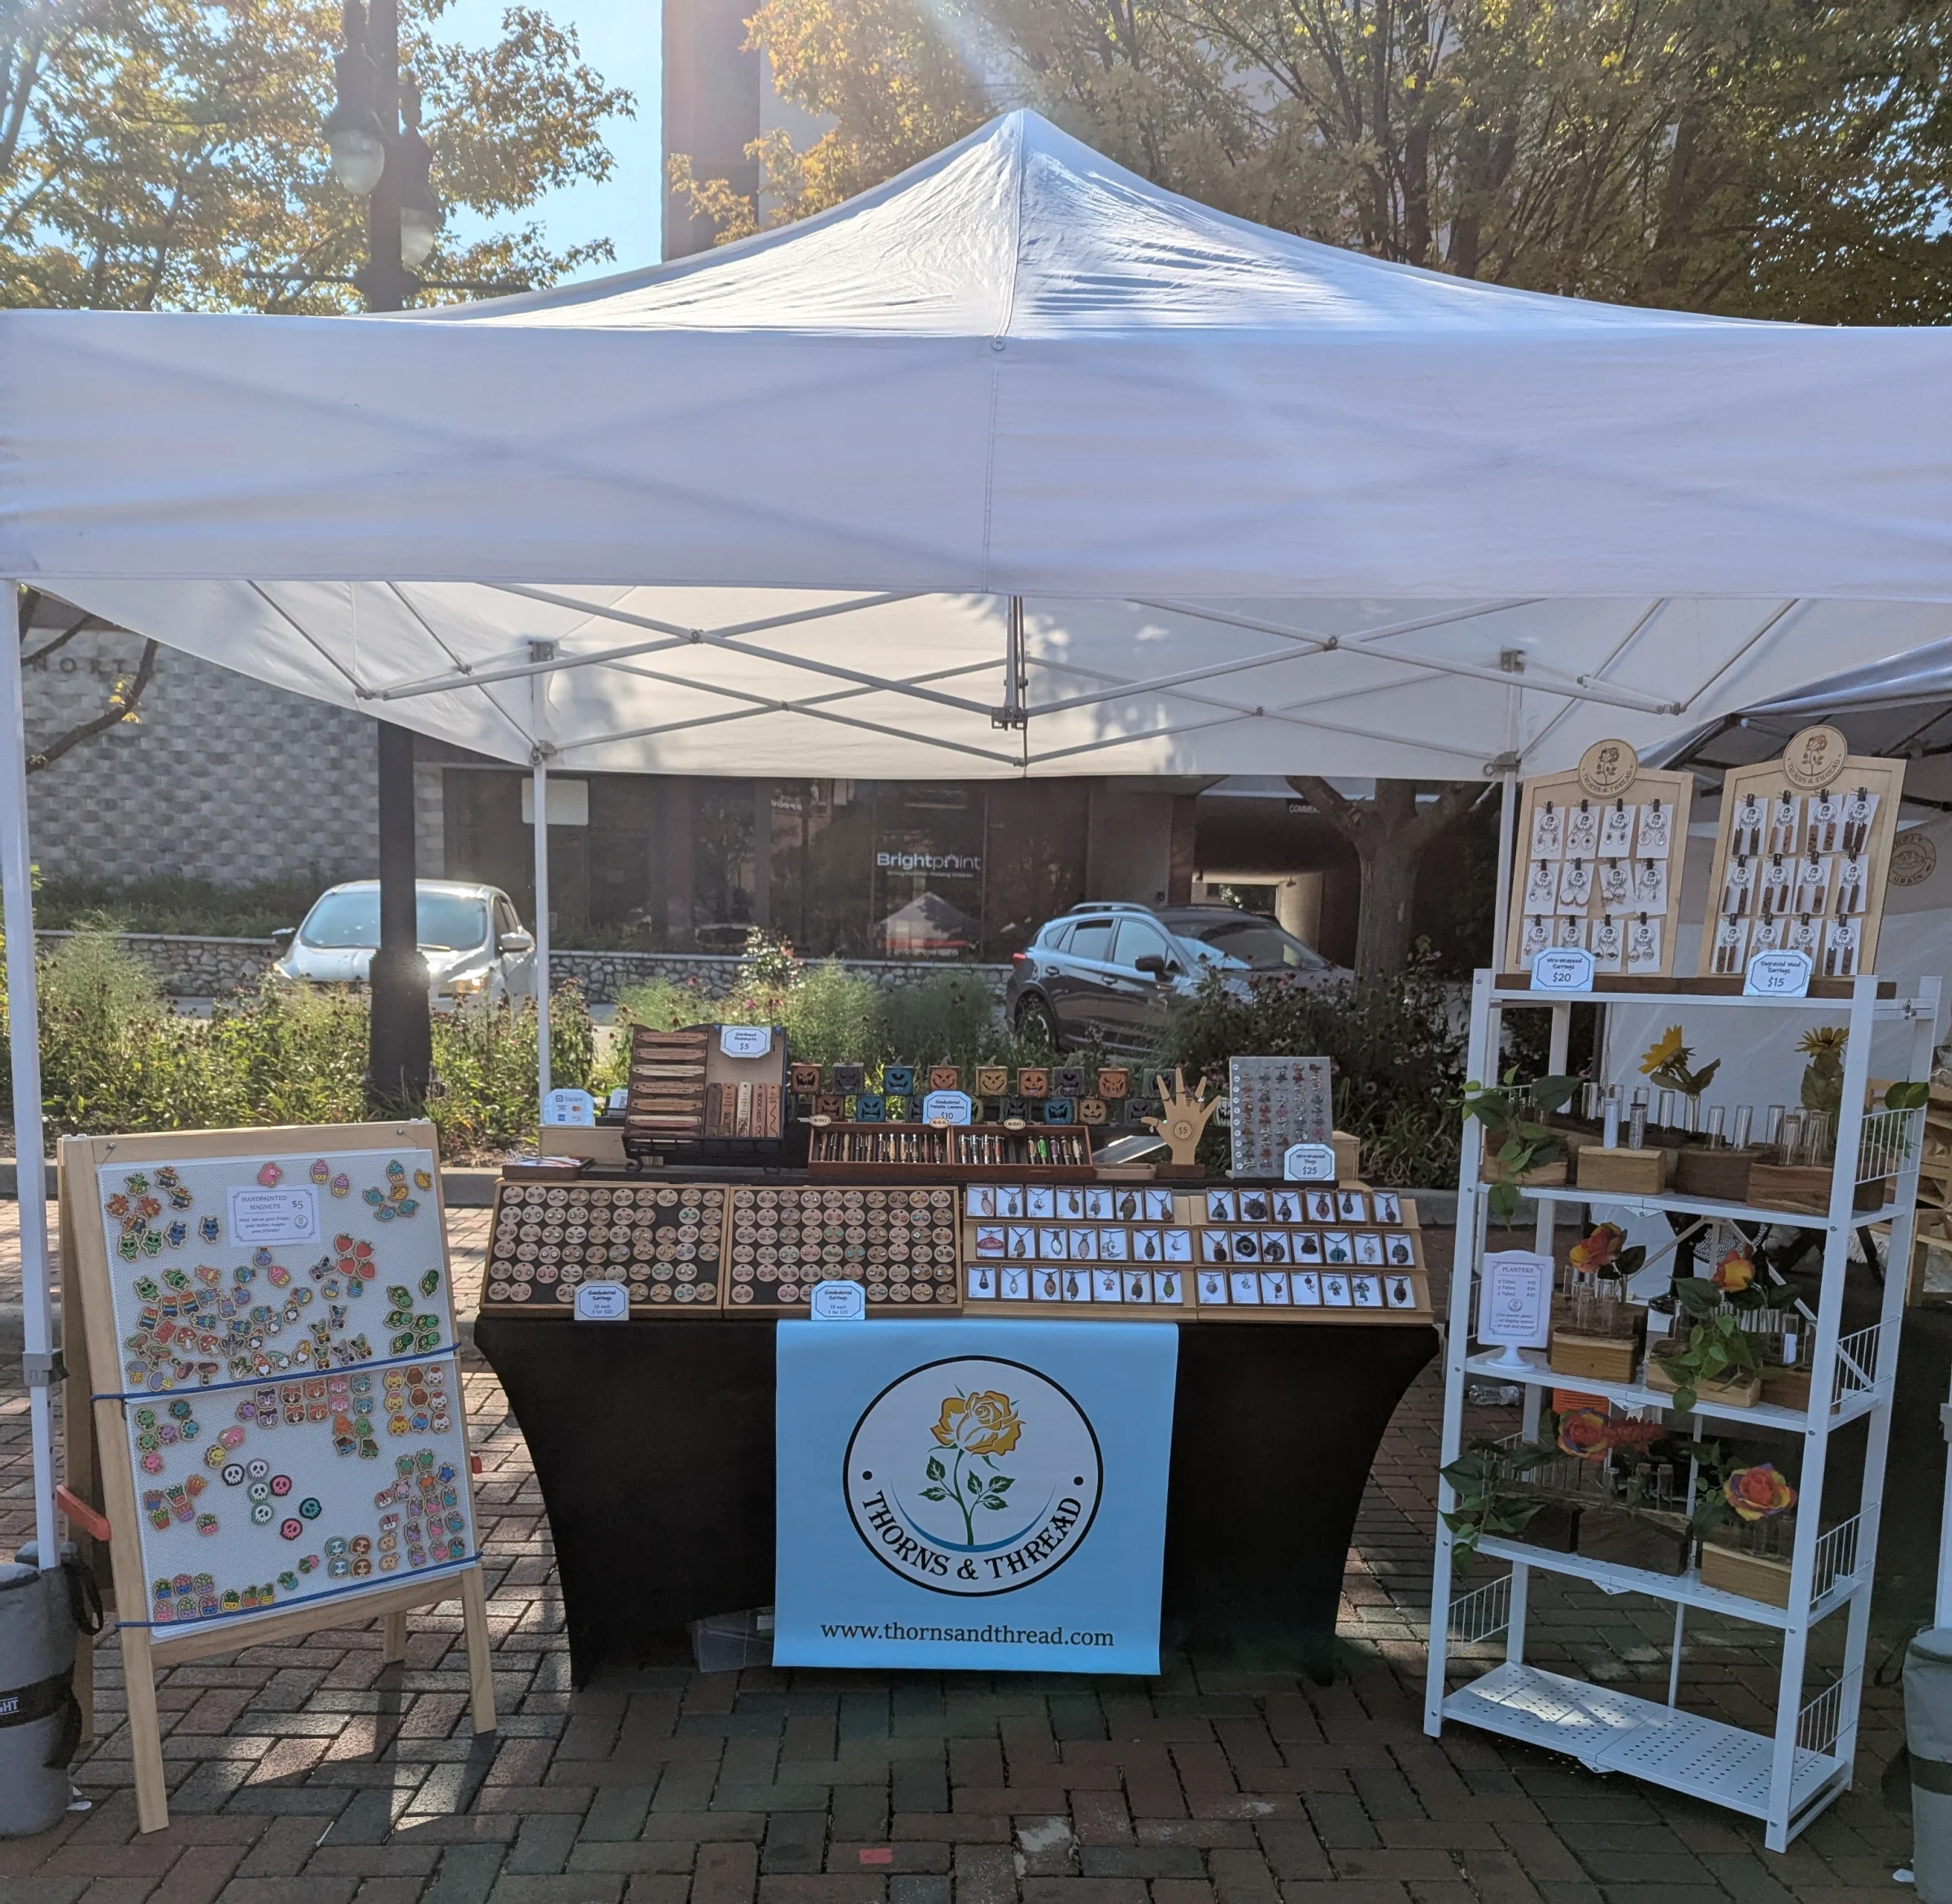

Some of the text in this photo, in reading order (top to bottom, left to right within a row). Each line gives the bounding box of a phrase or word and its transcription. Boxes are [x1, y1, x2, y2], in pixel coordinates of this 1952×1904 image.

[32, 654, 152, 674] NORT
[1815, 760, 1841, 782] THREAD
[1767, 967, 1791, 975] Earrings
[1553, 972, 1571, 982] $20
[1767, 976, 1784, 987] $15
[739, 1042, 749, 1050] $5
[940, 1111, 954, 1120] $10
[1179, 1126, 1187, 1135] $5
[1302, 1166, 1318, 1175] $25
[292, 1200, 303, 1209] $5
[862, 1489, 1082, 1580] THORNS & THREAD
[820, 1622, 1115, 1647] www.thornsandthread.com
